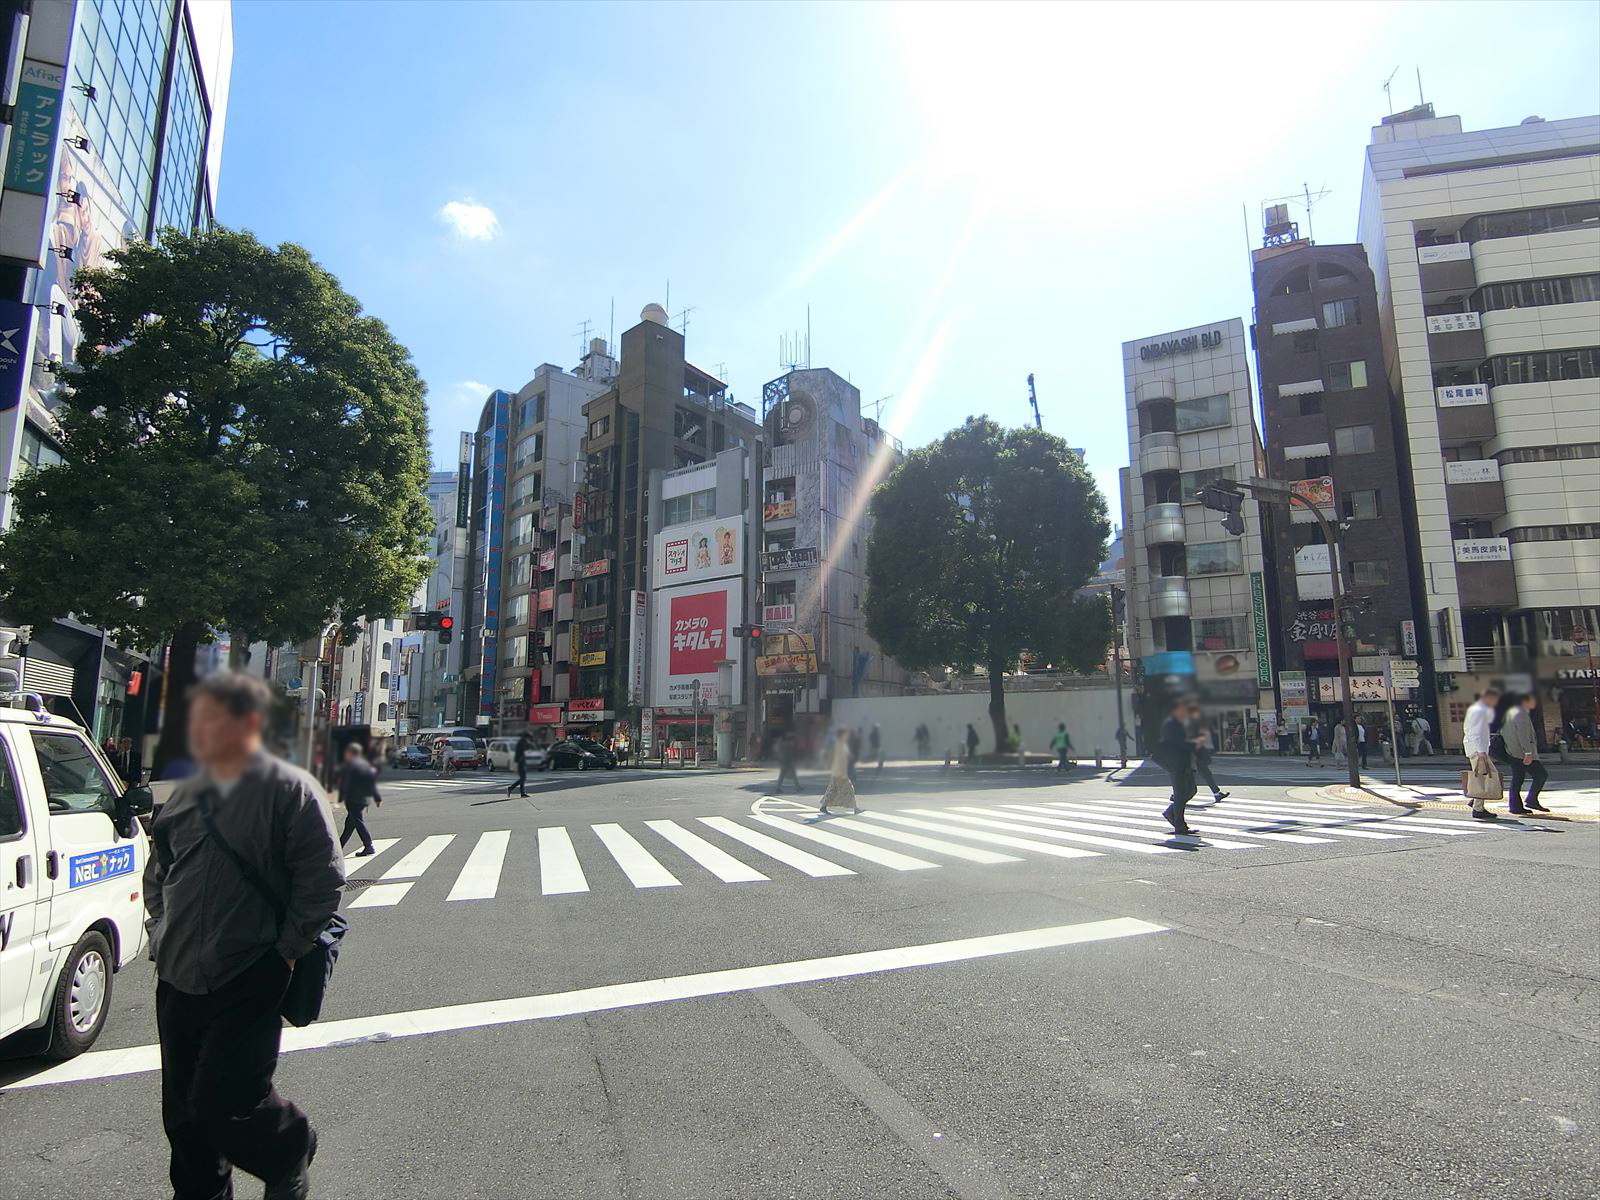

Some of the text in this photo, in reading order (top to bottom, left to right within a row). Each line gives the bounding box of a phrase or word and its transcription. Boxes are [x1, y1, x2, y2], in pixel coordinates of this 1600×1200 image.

[25, 66, 62, 83] Aflac
[26, 95, 55, 182] アフラック
[1140, 331, 1221, 361] OHBAYASHI BLD
[668, 549, 685, 557] スタジオ
[766, 607, 792, 620] NAIL
[674, 617, 708, 631] カメラの
[1252, 576, 1269, 683] FRESHNESS BURGER
[673, 629, 723, 651] キタムラ
[109, 853, 130, 872] ナック
